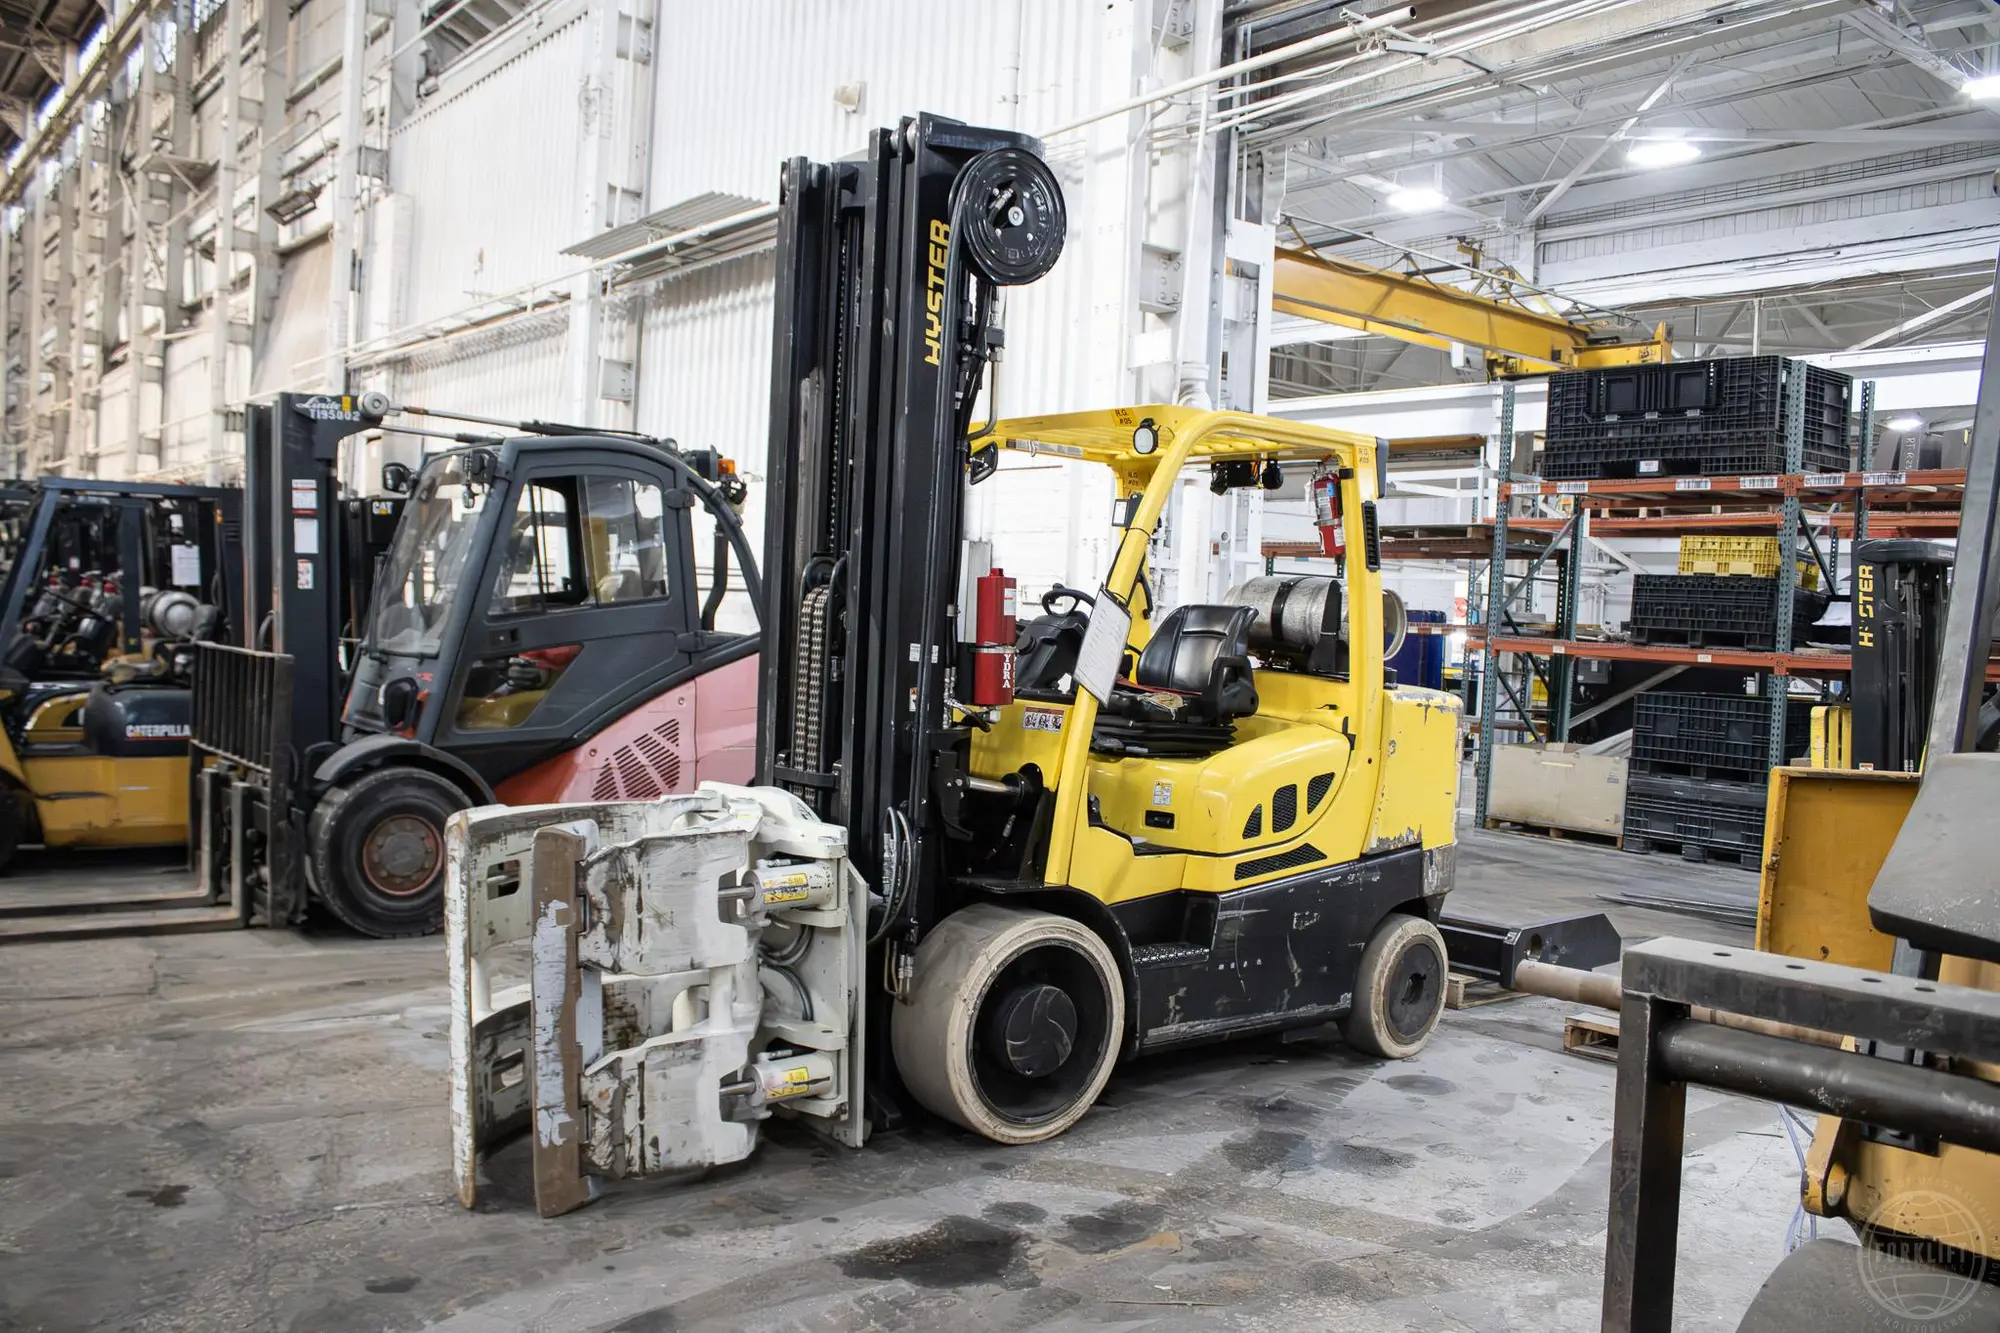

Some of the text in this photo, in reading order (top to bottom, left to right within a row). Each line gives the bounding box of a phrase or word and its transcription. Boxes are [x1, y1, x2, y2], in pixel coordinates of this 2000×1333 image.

[925, 219, 951, 366] HYSTER
[372, 501, 393, 515] CAT
[1859, 564, 1874, 648] HSTER
[1002, 653, 1012, 688] YDRA
[126, 724, 192, 738] CATERPILLA
